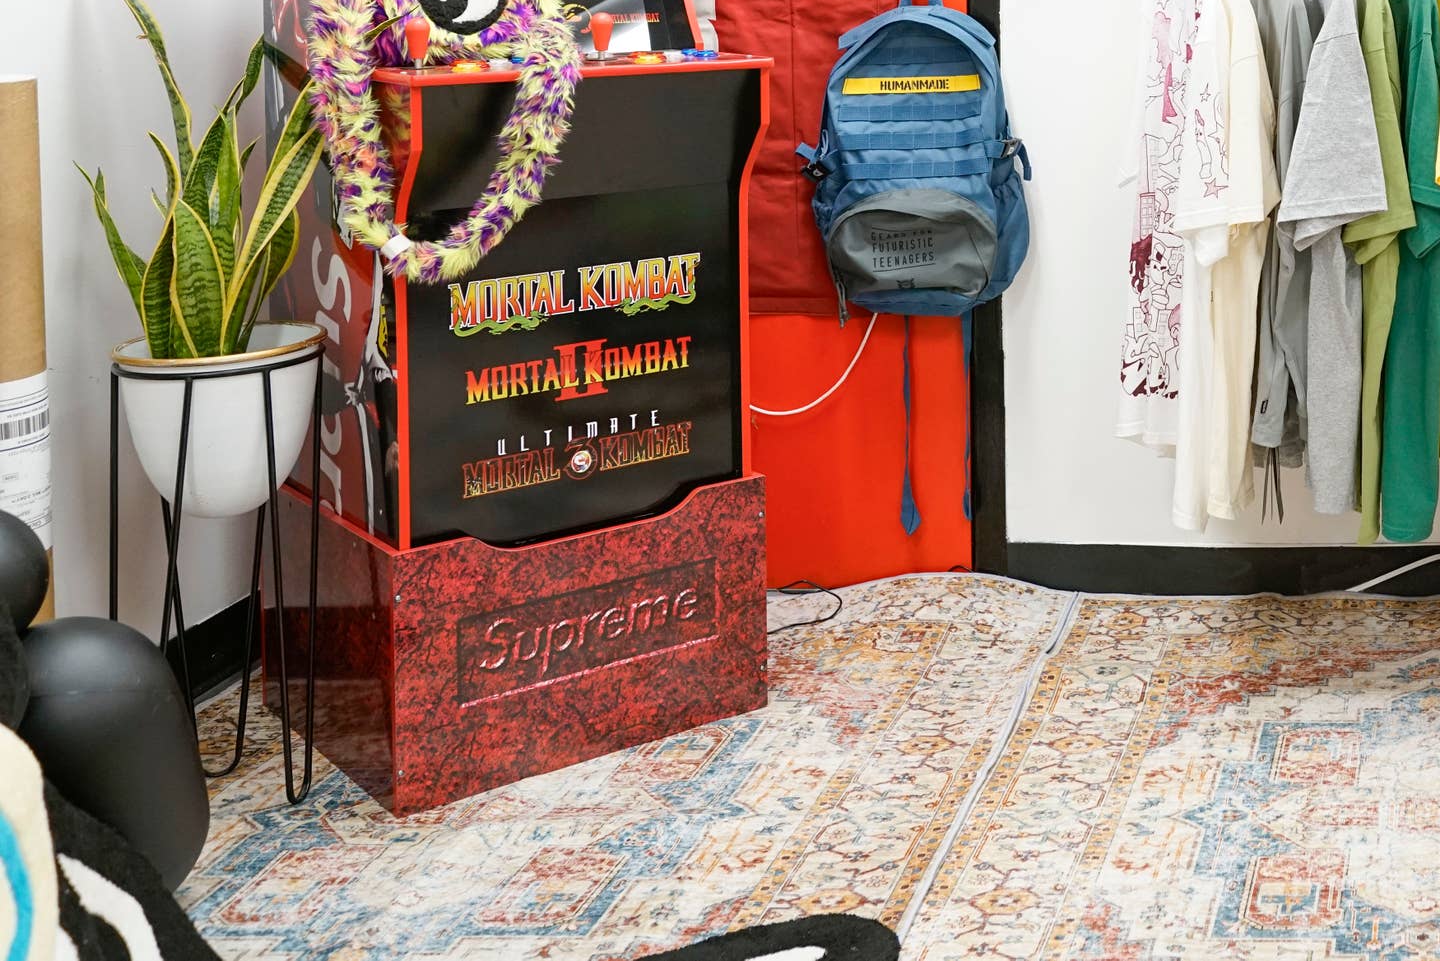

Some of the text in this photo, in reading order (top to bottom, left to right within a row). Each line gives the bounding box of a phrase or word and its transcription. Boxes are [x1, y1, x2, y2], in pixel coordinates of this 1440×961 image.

[879, 78, 950, 91] HUMANMADE
[872, 236, 933, 253] FUTURISTIC
[872, 251, 935, 268] TEENAGERS
[448, 253, 701, 331] MORTAL KOMBAT
[465, 336, 691, 405] MORTAL KOMBAT
[462, 447, 561, 499] MORTAL
[600, 421, 692, 472] KOMBAT
[497, 409, 661, 456] ULTIMATE
[479, 588, 698, 679] Supreme
